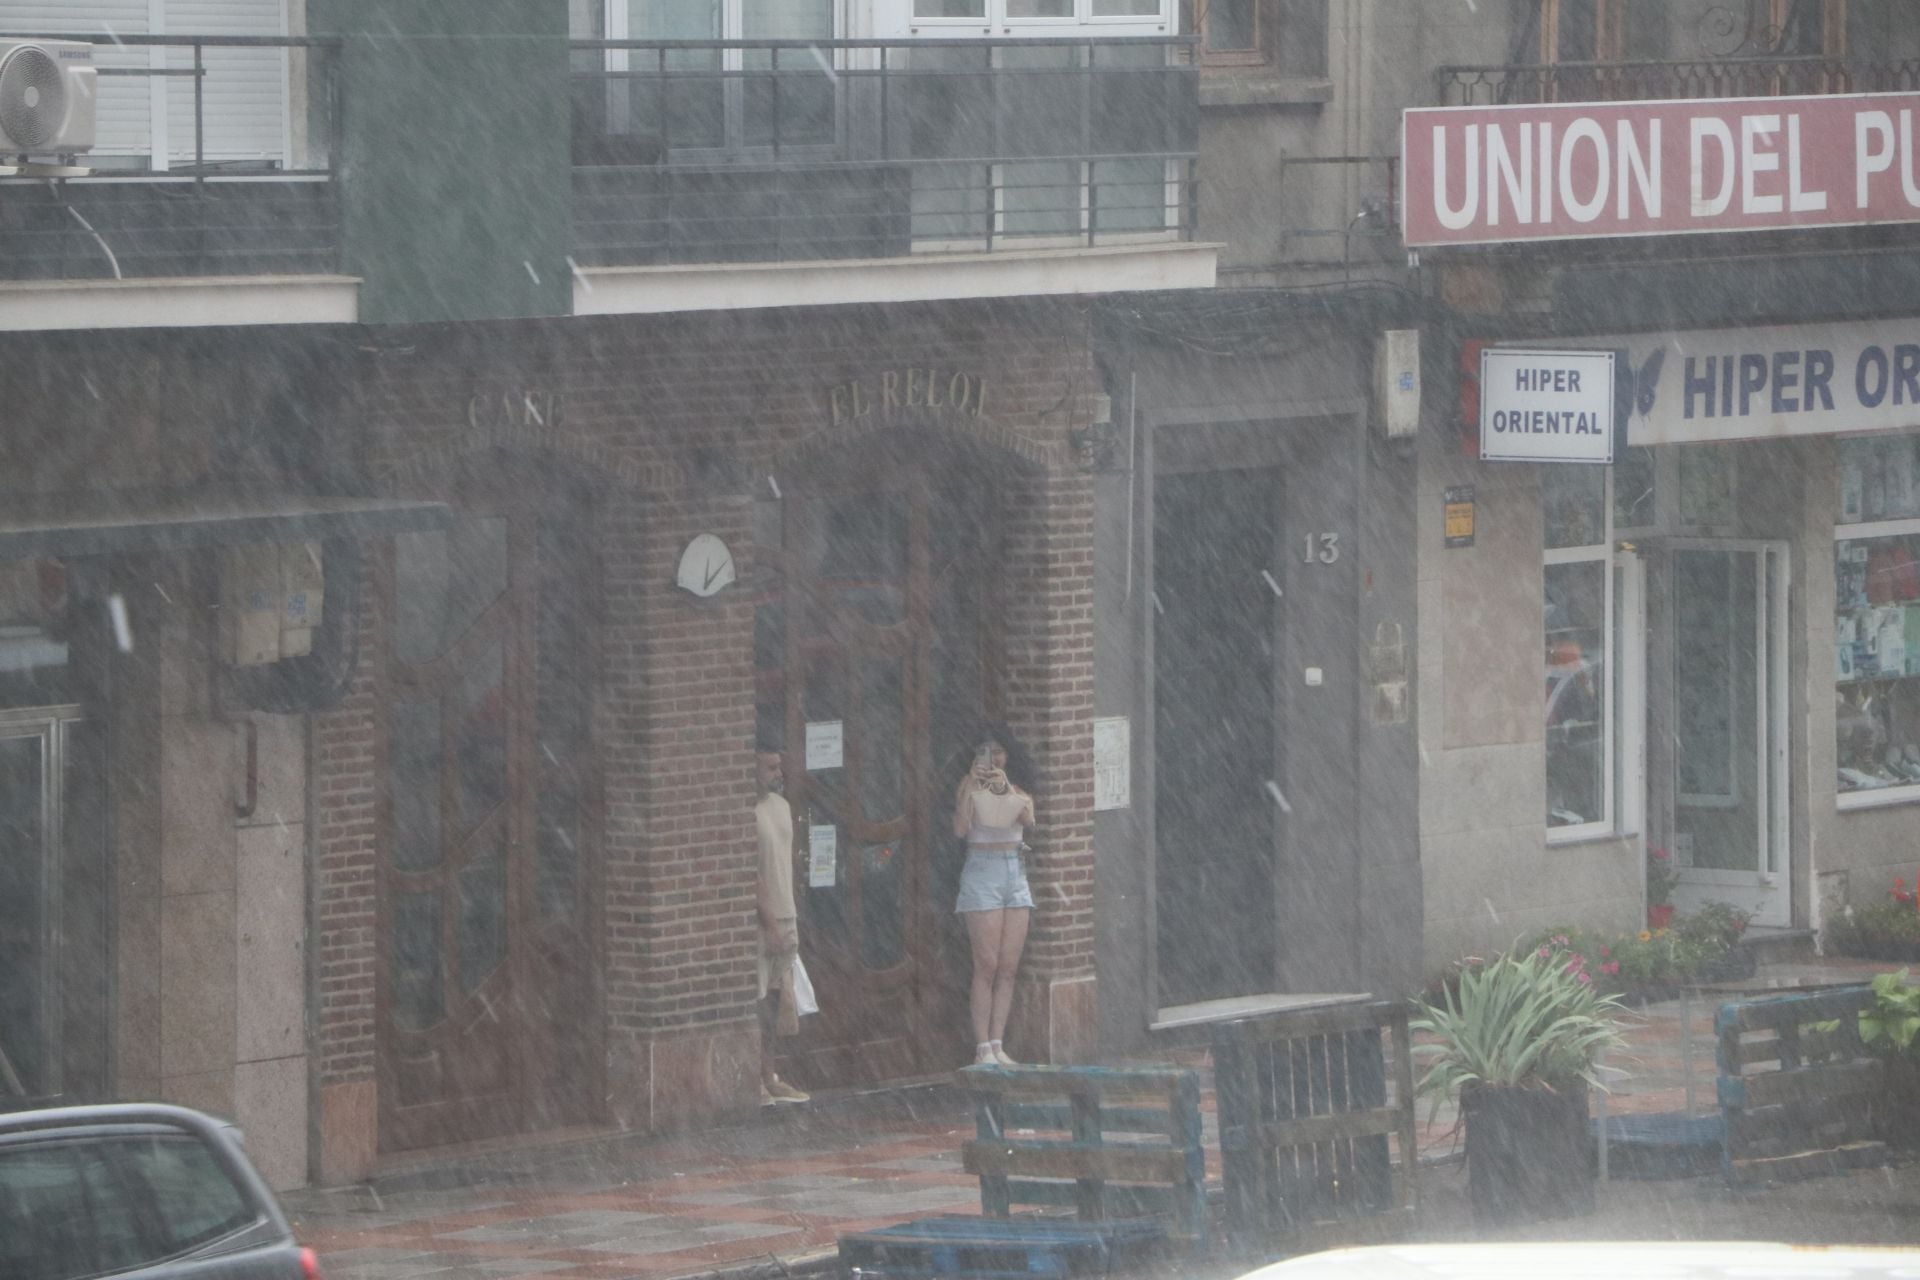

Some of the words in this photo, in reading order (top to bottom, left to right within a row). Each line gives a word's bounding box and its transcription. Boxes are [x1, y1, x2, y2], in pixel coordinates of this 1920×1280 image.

[1433, 118, 1662, 230] UNION
[1690, 113, 1827, 218] DEL
[832, 379, 871, 427] EL
[880, 367, 989, 418] RELOJ
[1516, 368, 1582, 392] HIPER
[1684, 349, 1836, 420] HIPER
[1855, 344, 1920, 408] OR
[1493, 409, 1603, 435] ORIENTAL
[1304, 532, 1340, 564] 13
